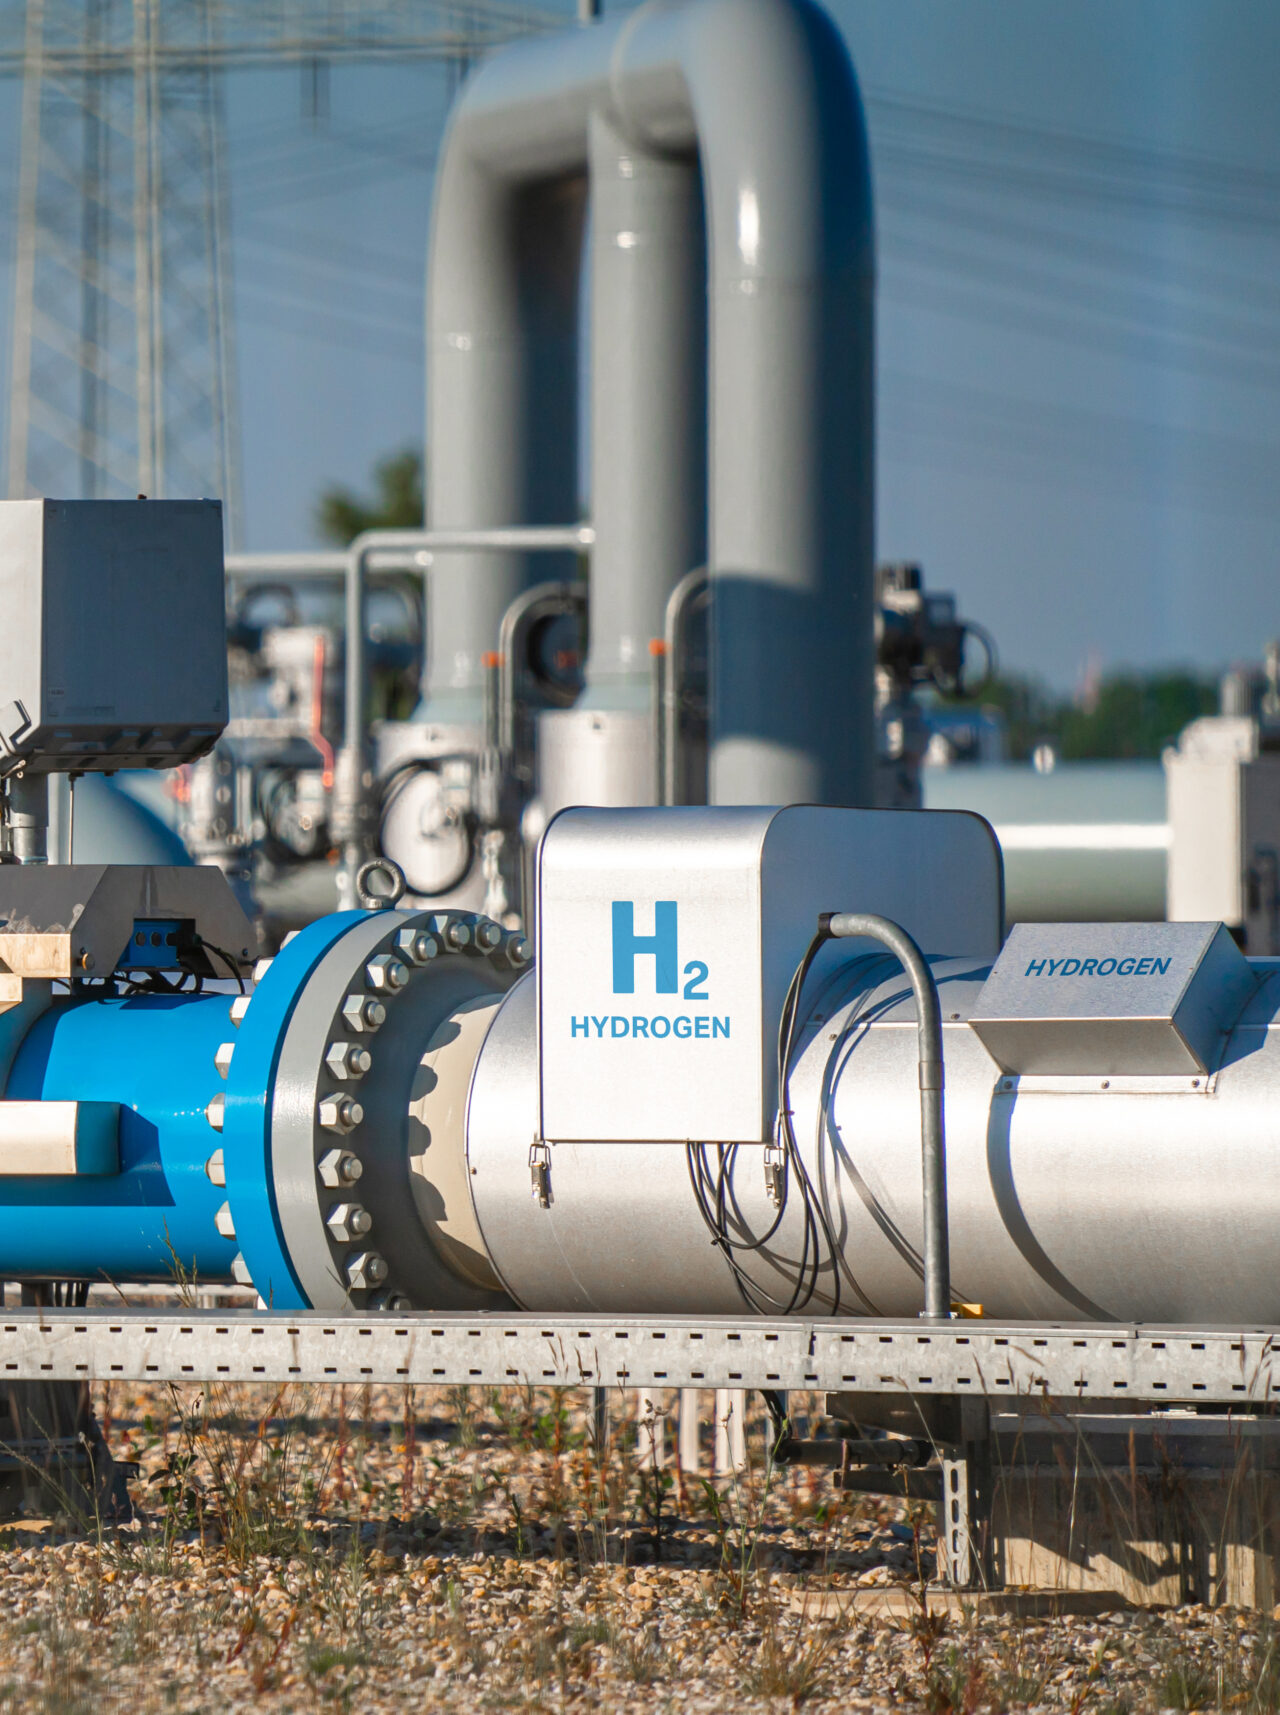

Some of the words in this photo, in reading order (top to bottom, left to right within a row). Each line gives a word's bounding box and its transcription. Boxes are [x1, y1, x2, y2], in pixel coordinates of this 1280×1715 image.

[612, 901, 709, 1000] H2
[1024, 957, 1173, 977] HYDROGEN
[571, 1016, 731, 1038] HYDROGEN
